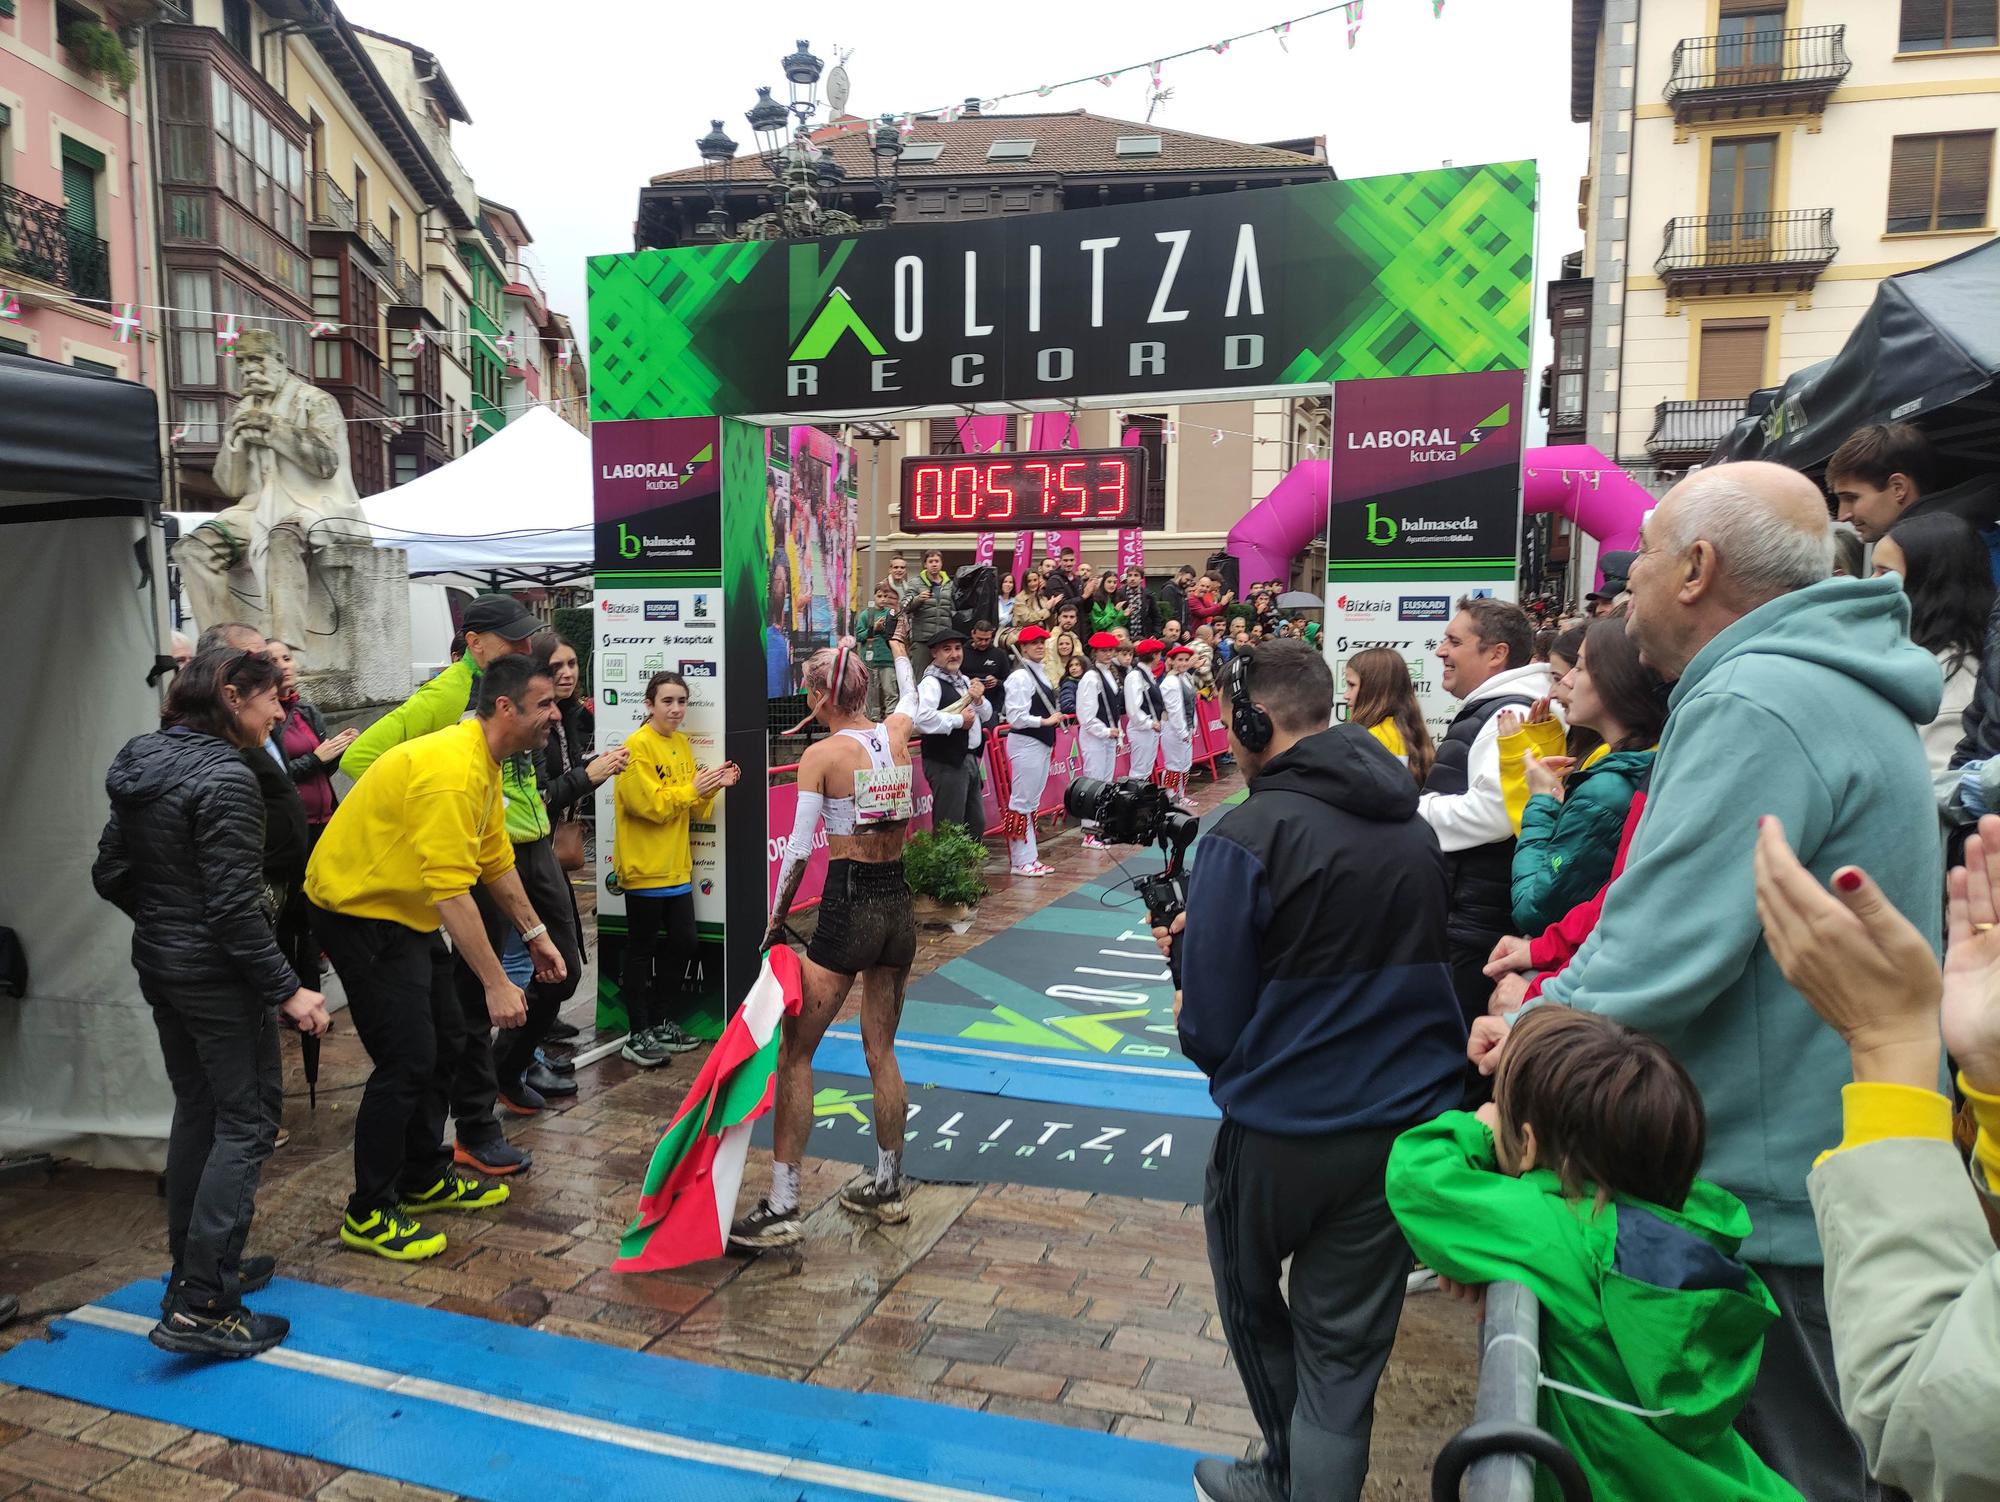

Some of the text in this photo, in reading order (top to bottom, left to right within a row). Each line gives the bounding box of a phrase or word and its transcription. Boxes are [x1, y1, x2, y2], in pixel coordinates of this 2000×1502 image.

[788, 223, 1265, 361] KOLITZA
[787, 334, 1265, 397] RECORD
[1348, 428, 1457, 449] LABORAL
[1410, 449, 1457, 462] kutxa
[602, 463, 678, 479] LABORAL
[646, 480, 678, 490] kutxa
[914, 460, 1127, 520] 00:57:53
[1401, 516, 1478, 531] balmaseda
[642, 535, 696, 547] balmaseda
[607, 604, 640, 614] Bizkaia
[1346, 600, 1392, 612] Bizkaia
[875, 792, 906, 801] FLOREA
